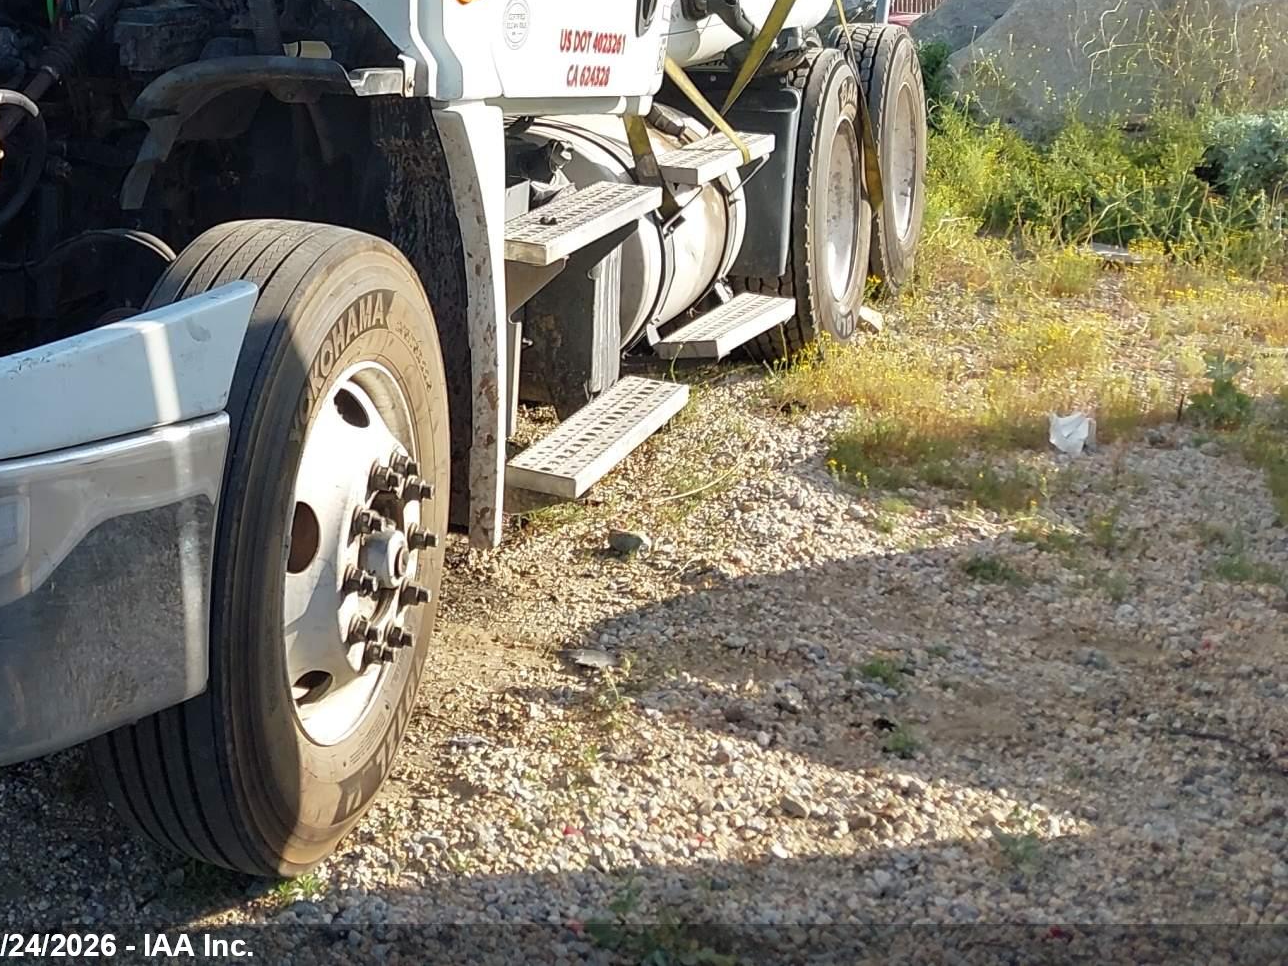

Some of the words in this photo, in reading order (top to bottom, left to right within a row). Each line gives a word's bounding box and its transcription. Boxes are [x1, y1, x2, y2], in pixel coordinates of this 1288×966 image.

[560, 28, 573, 53] US
[573, 30, 593, 54] DOT
[567, 64, 579, 87] CA
[579, 65, 611, 87] 624328
